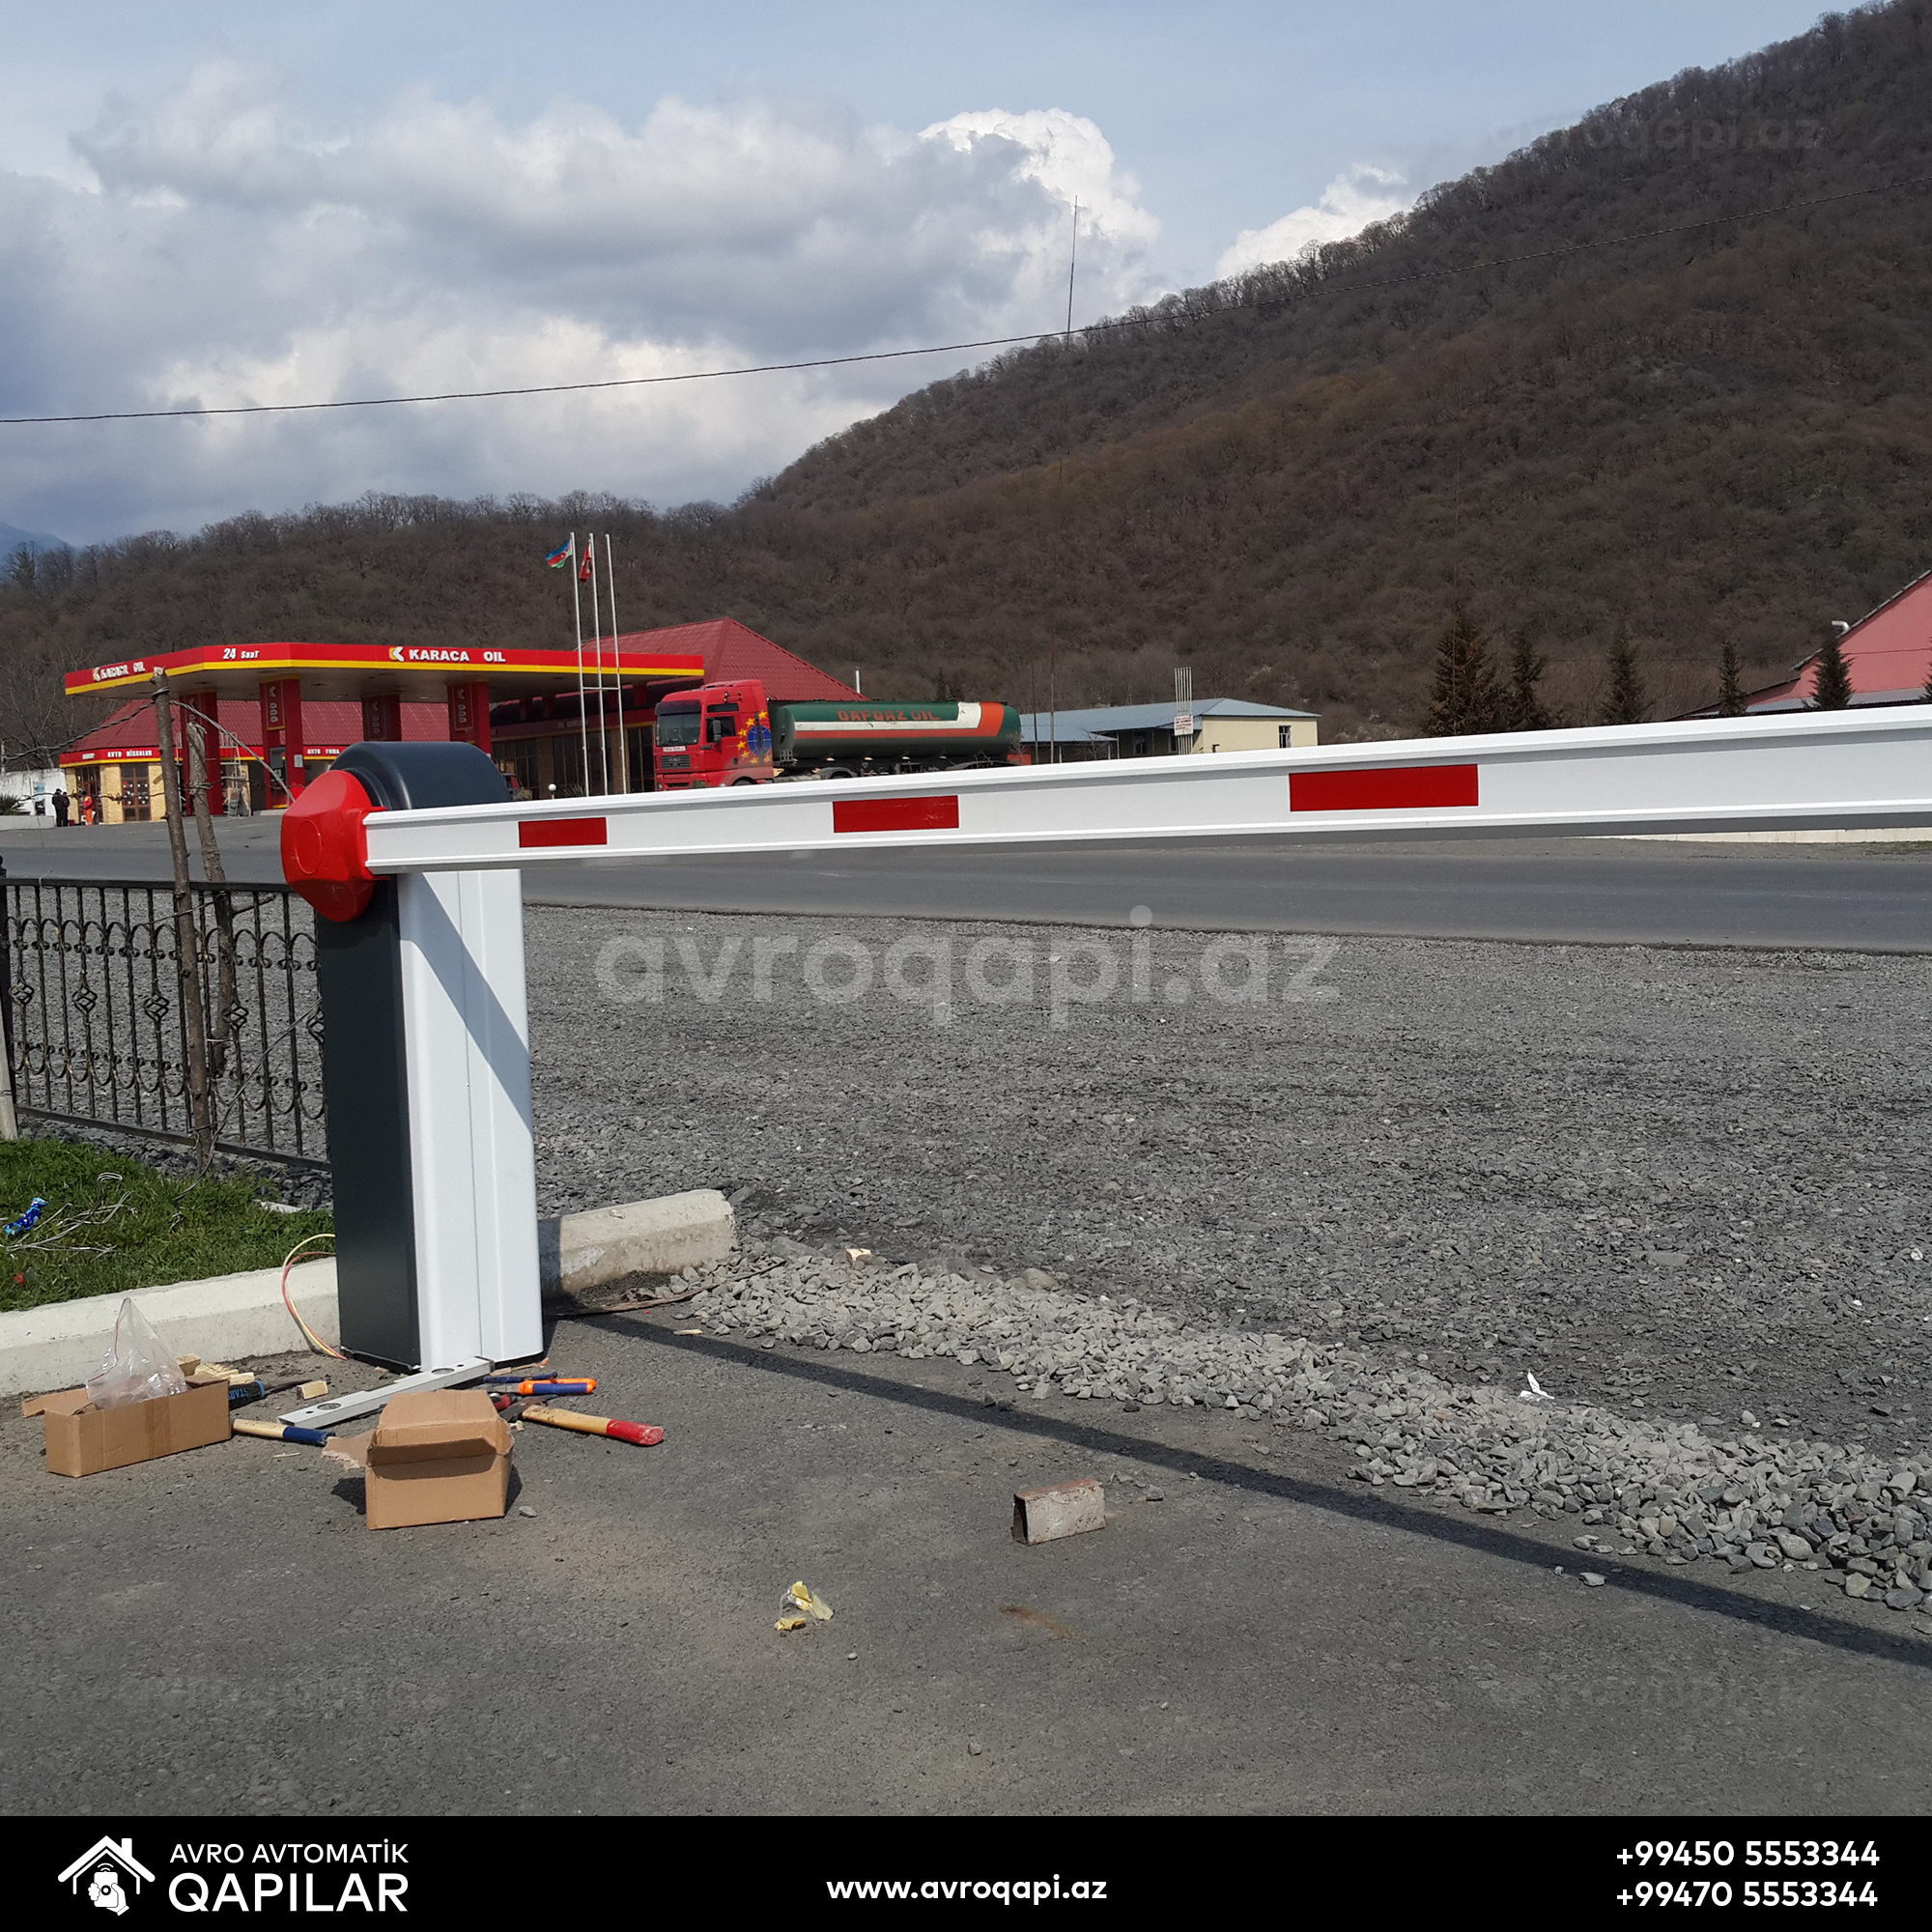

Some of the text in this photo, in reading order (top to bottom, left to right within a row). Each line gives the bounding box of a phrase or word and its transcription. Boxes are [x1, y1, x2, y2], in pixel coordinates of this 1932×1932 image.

[223, 647, 237, 660] 24
[409, 649, 506, 663] KARACA OIL
